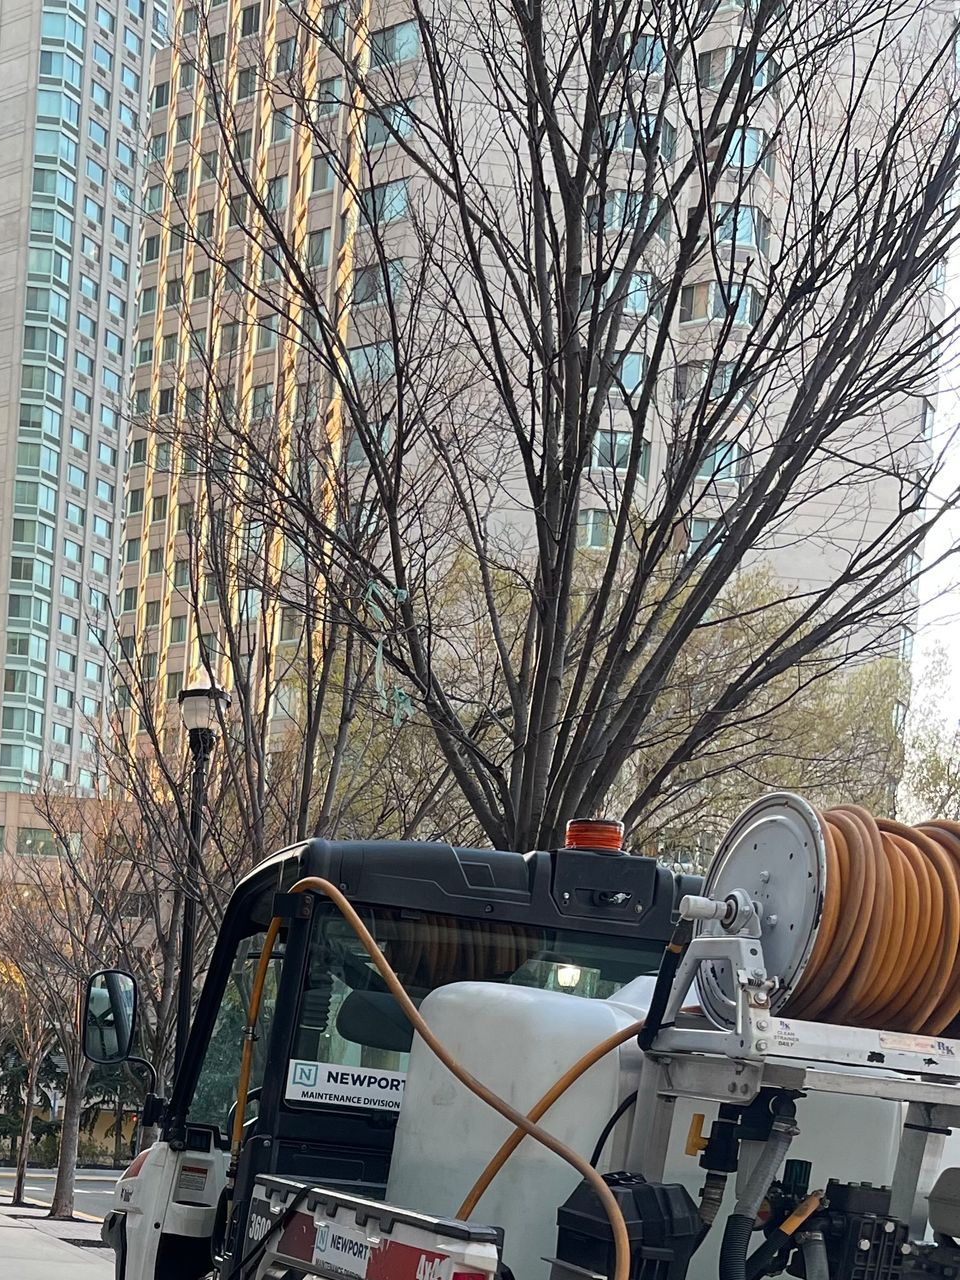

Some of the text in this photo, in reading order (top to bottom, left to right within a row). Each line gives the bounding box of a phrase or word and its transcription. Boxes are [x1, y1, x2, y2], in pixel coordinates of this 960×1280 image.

[299, 1068, 406, 1092] N NEWPORT
[301, 1091, 401, 1109] MAINTENANCE DIVISION
[248, 1213, 272, 1241] 3600
[330, 1233, 369, 1260] NEWPORT
